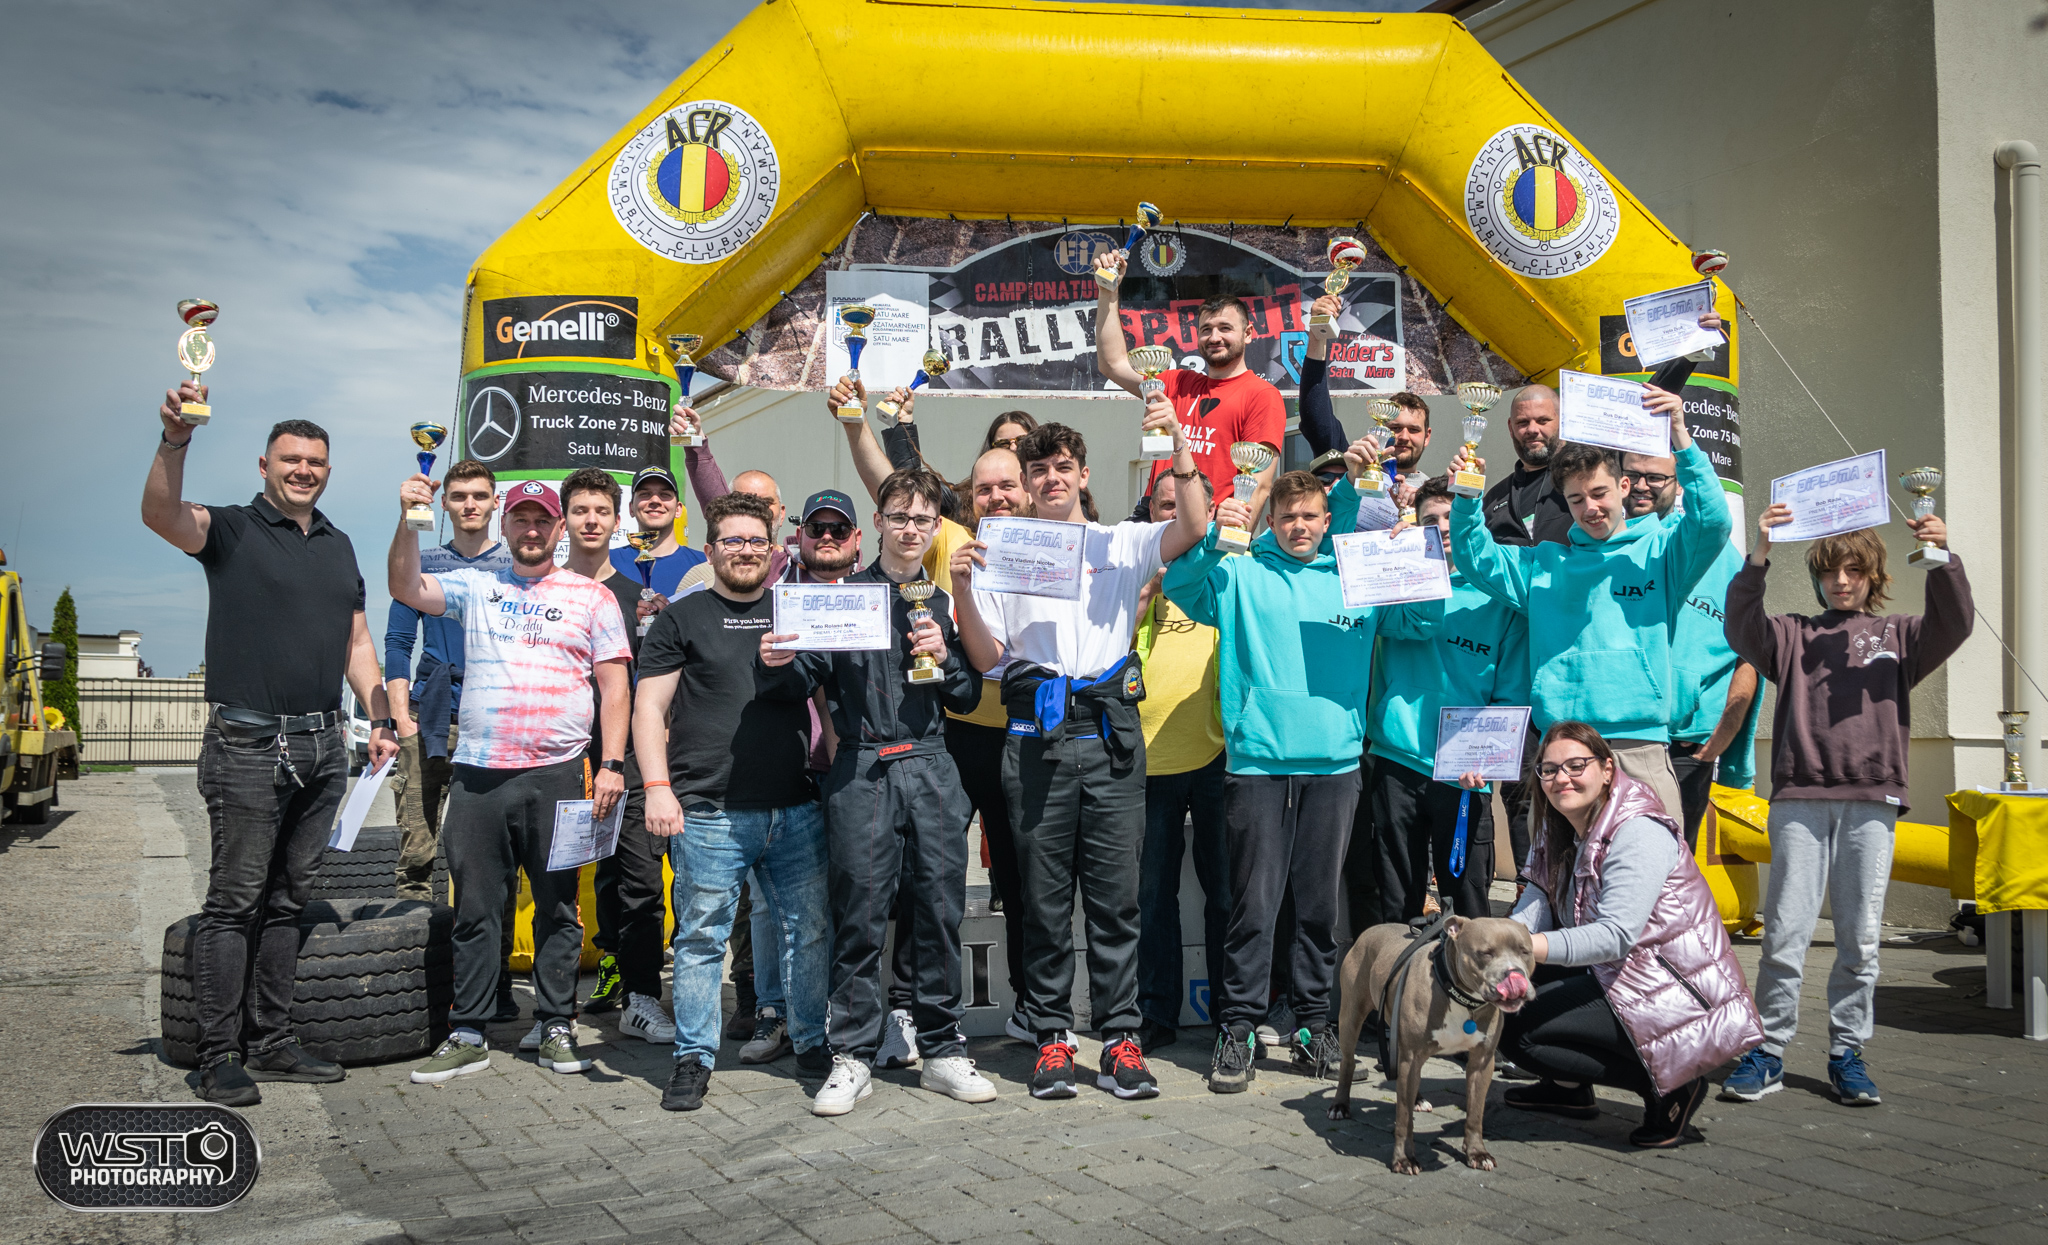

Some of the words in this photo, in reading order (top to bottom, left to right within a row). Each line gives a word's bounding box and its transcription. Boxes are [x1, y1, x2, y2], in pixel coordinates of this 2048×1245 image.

[666, 108, 733, 151] ACR
[1512, 134, 1569, 174] ACR
[1329, 342, 1394, 362] Rider's
[1329, 366, 1355, 378] Satu
[1364, 366, 1395, 378] Mare
[528, 385, 667, 412] Mercedes-Benz
[531, 415, 574, 429] Truck
[578, 415, 617, 430] Zone
[620, 418, 638, 432] 75
[642, 419, 665, 437] BNK
[1692, 425, 1719, 440] Zone
[1720, 430, 1731, 443] 75
[567, 442, 600, 455] Satu
[605, 443, 638, 458] Mare
[1712, 452, 1732, 466] Mare
[1614, 579, 1656, 596] JAR
[500, 602, 547, 617] BLUE
[1687, 597, 1725, 623] JAR
[499, 617, 543, 636] Daddy
[1328, 614, 1364, 629] JAR
[522, 632, 551, 649] You
[1447, 635, 1491, 657] JAR
